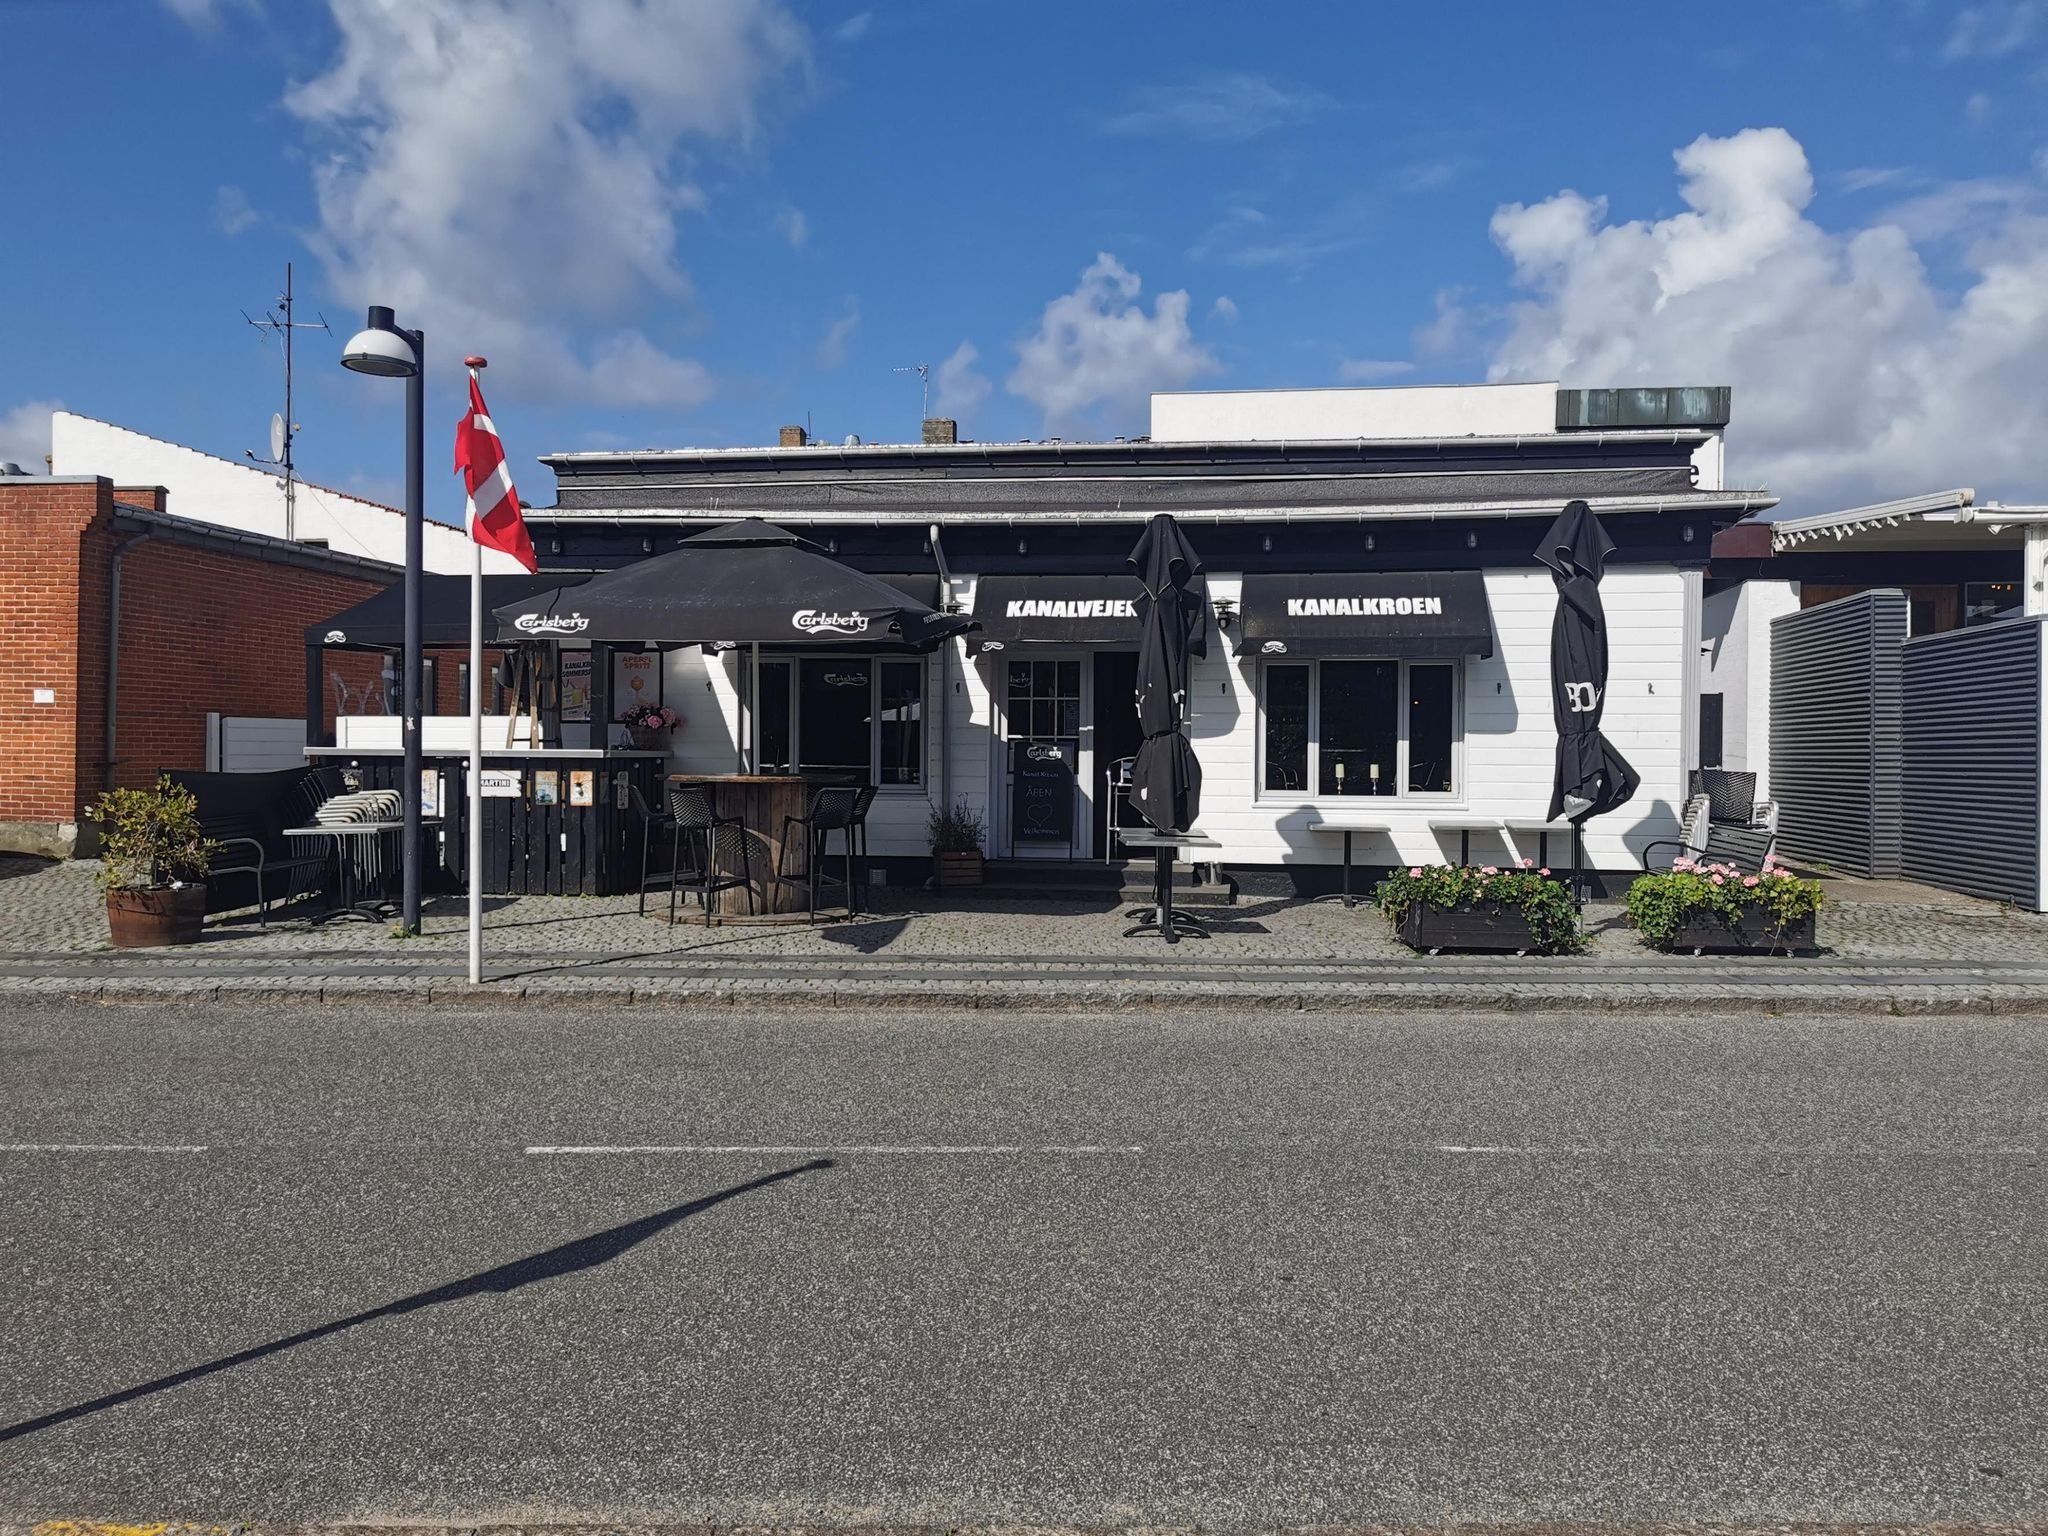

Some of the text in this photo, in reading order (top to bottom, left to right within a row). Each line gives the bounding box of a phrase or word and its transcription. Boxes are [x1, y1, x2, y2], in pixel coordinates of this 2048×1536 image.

[1287, 597, 1442, 616] KANALKROEN
[514, 612, 590, 634] Carlsberg
[792, 609, 869, 634] Carlsberg
[1026, 746, 1062, 761] Carlsberg
[480, 778, 511, 787] MARTINI
[1025, 784, 1052, 798] ÅBEN
